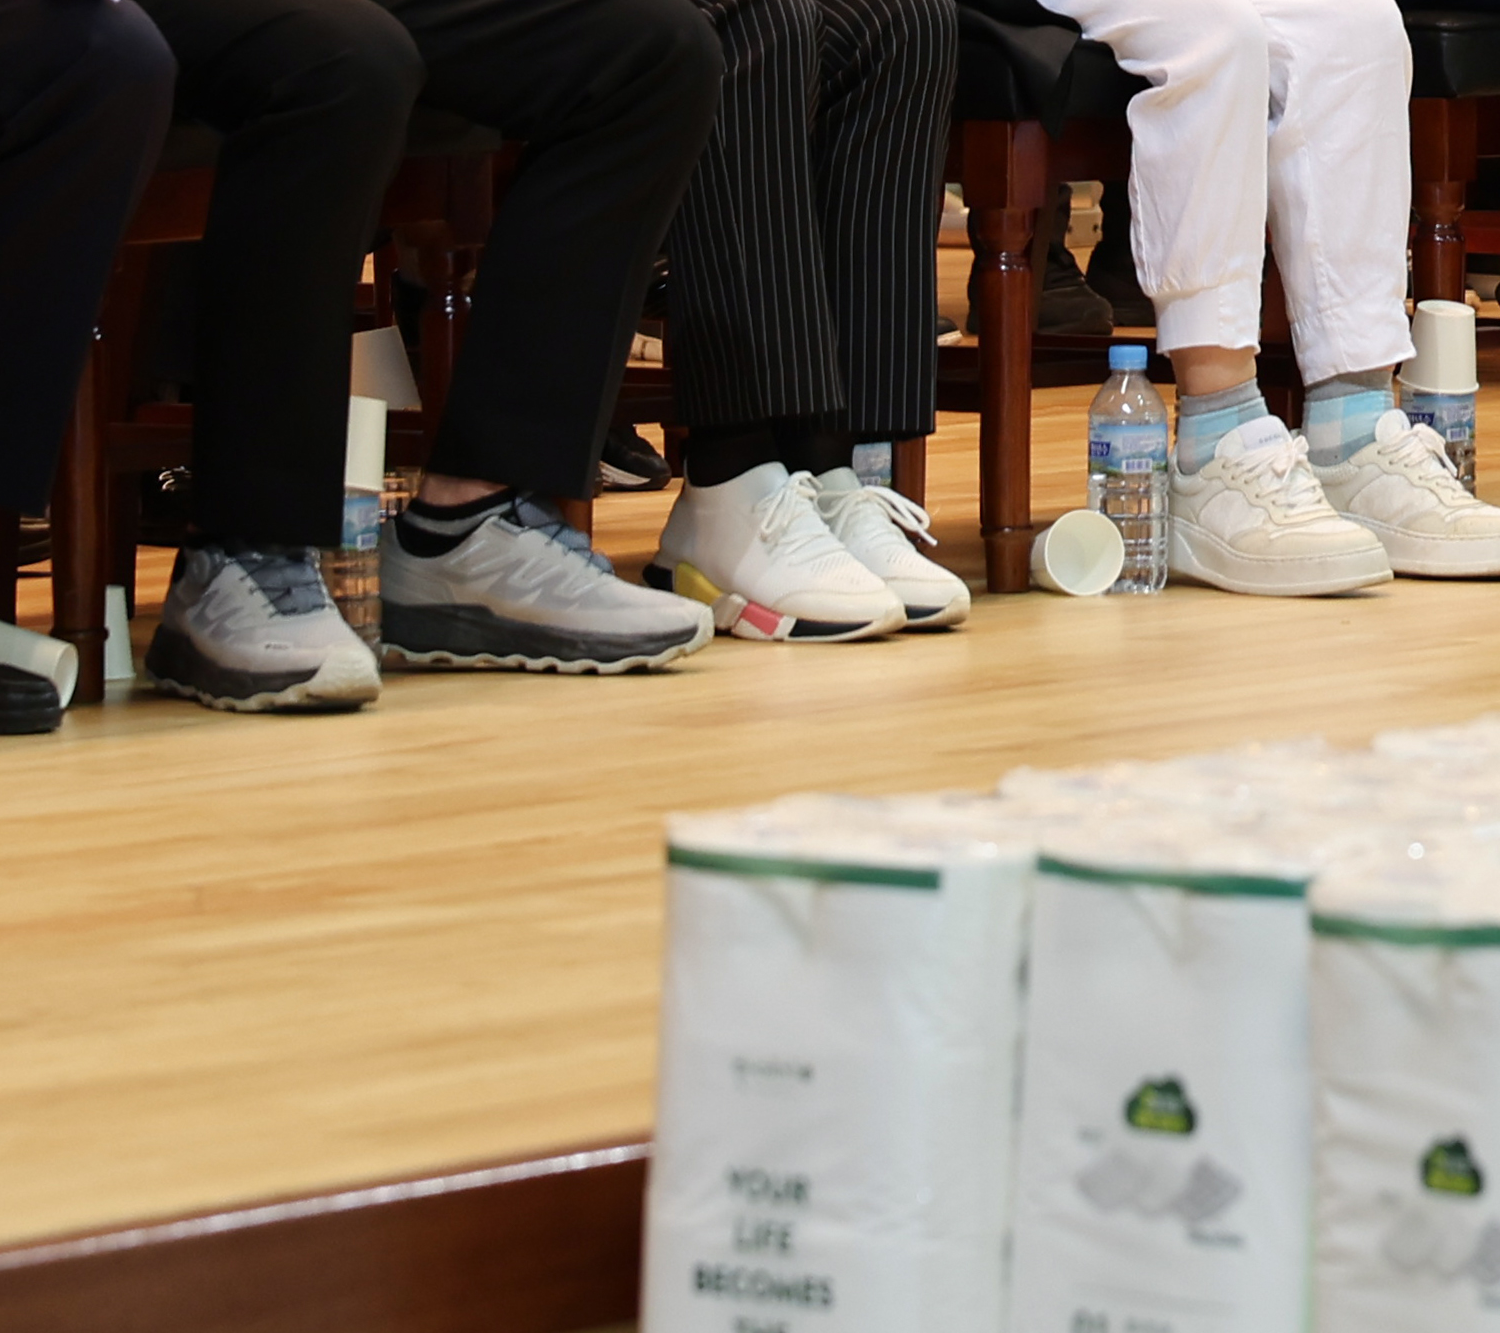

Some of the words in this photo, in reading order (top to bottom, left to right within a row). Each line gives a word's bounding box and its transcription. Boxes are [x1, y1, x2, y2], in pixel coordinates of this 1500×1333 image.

[726, 1167, 810, 1204] YOUR
[733, 1219, 793, 1255] LIFE
[692, 1263, 835, 1310] BECOMES
